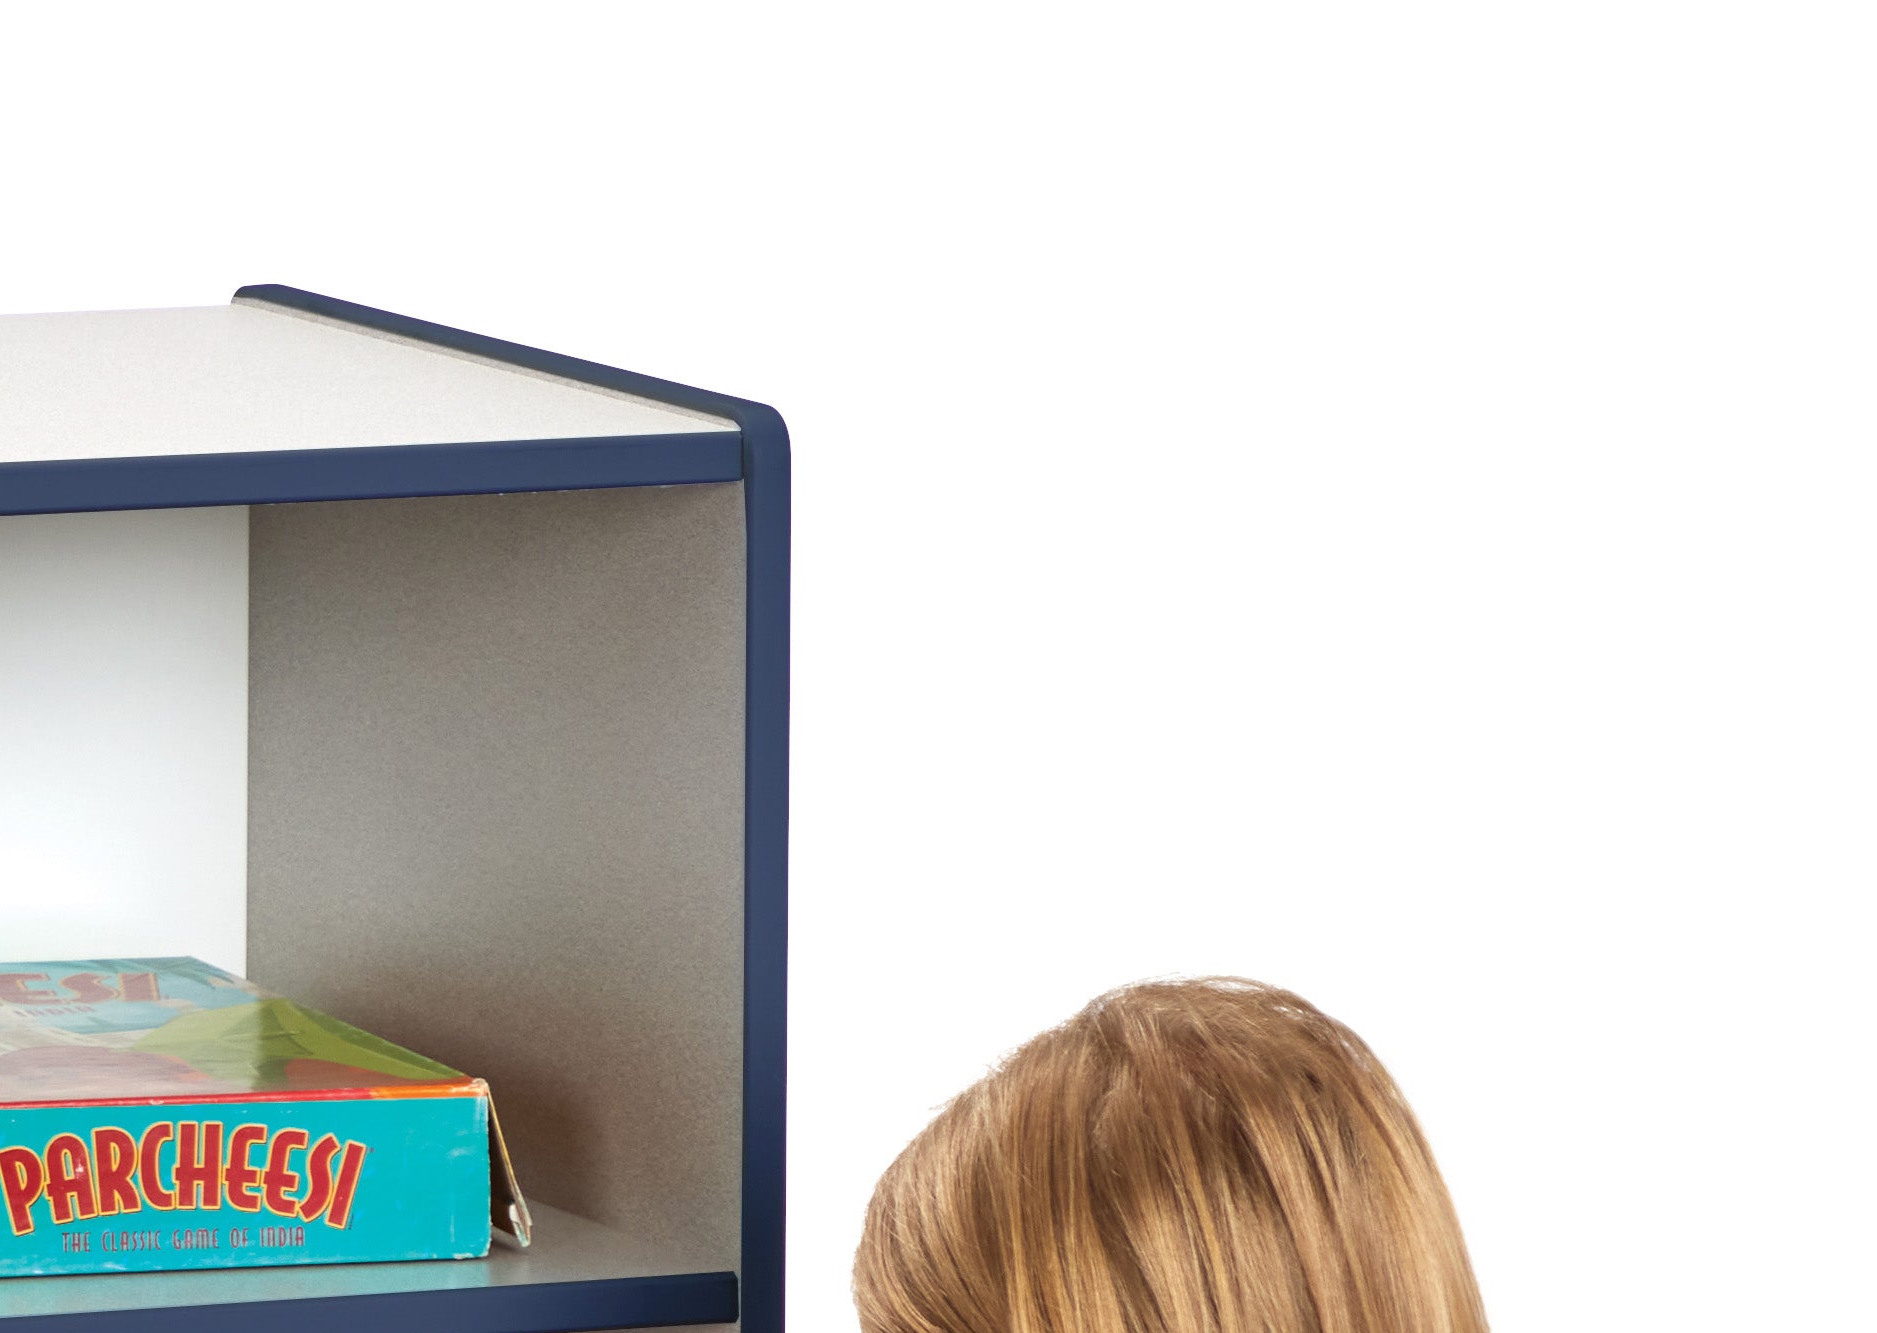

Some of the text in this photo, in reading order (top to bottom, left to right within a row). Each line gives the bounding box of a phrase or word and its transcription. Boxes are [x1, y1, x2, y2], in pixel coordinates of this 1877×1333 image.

[62, 1226, 306, 1253] THE CLASSIC GAME OF INDIA
